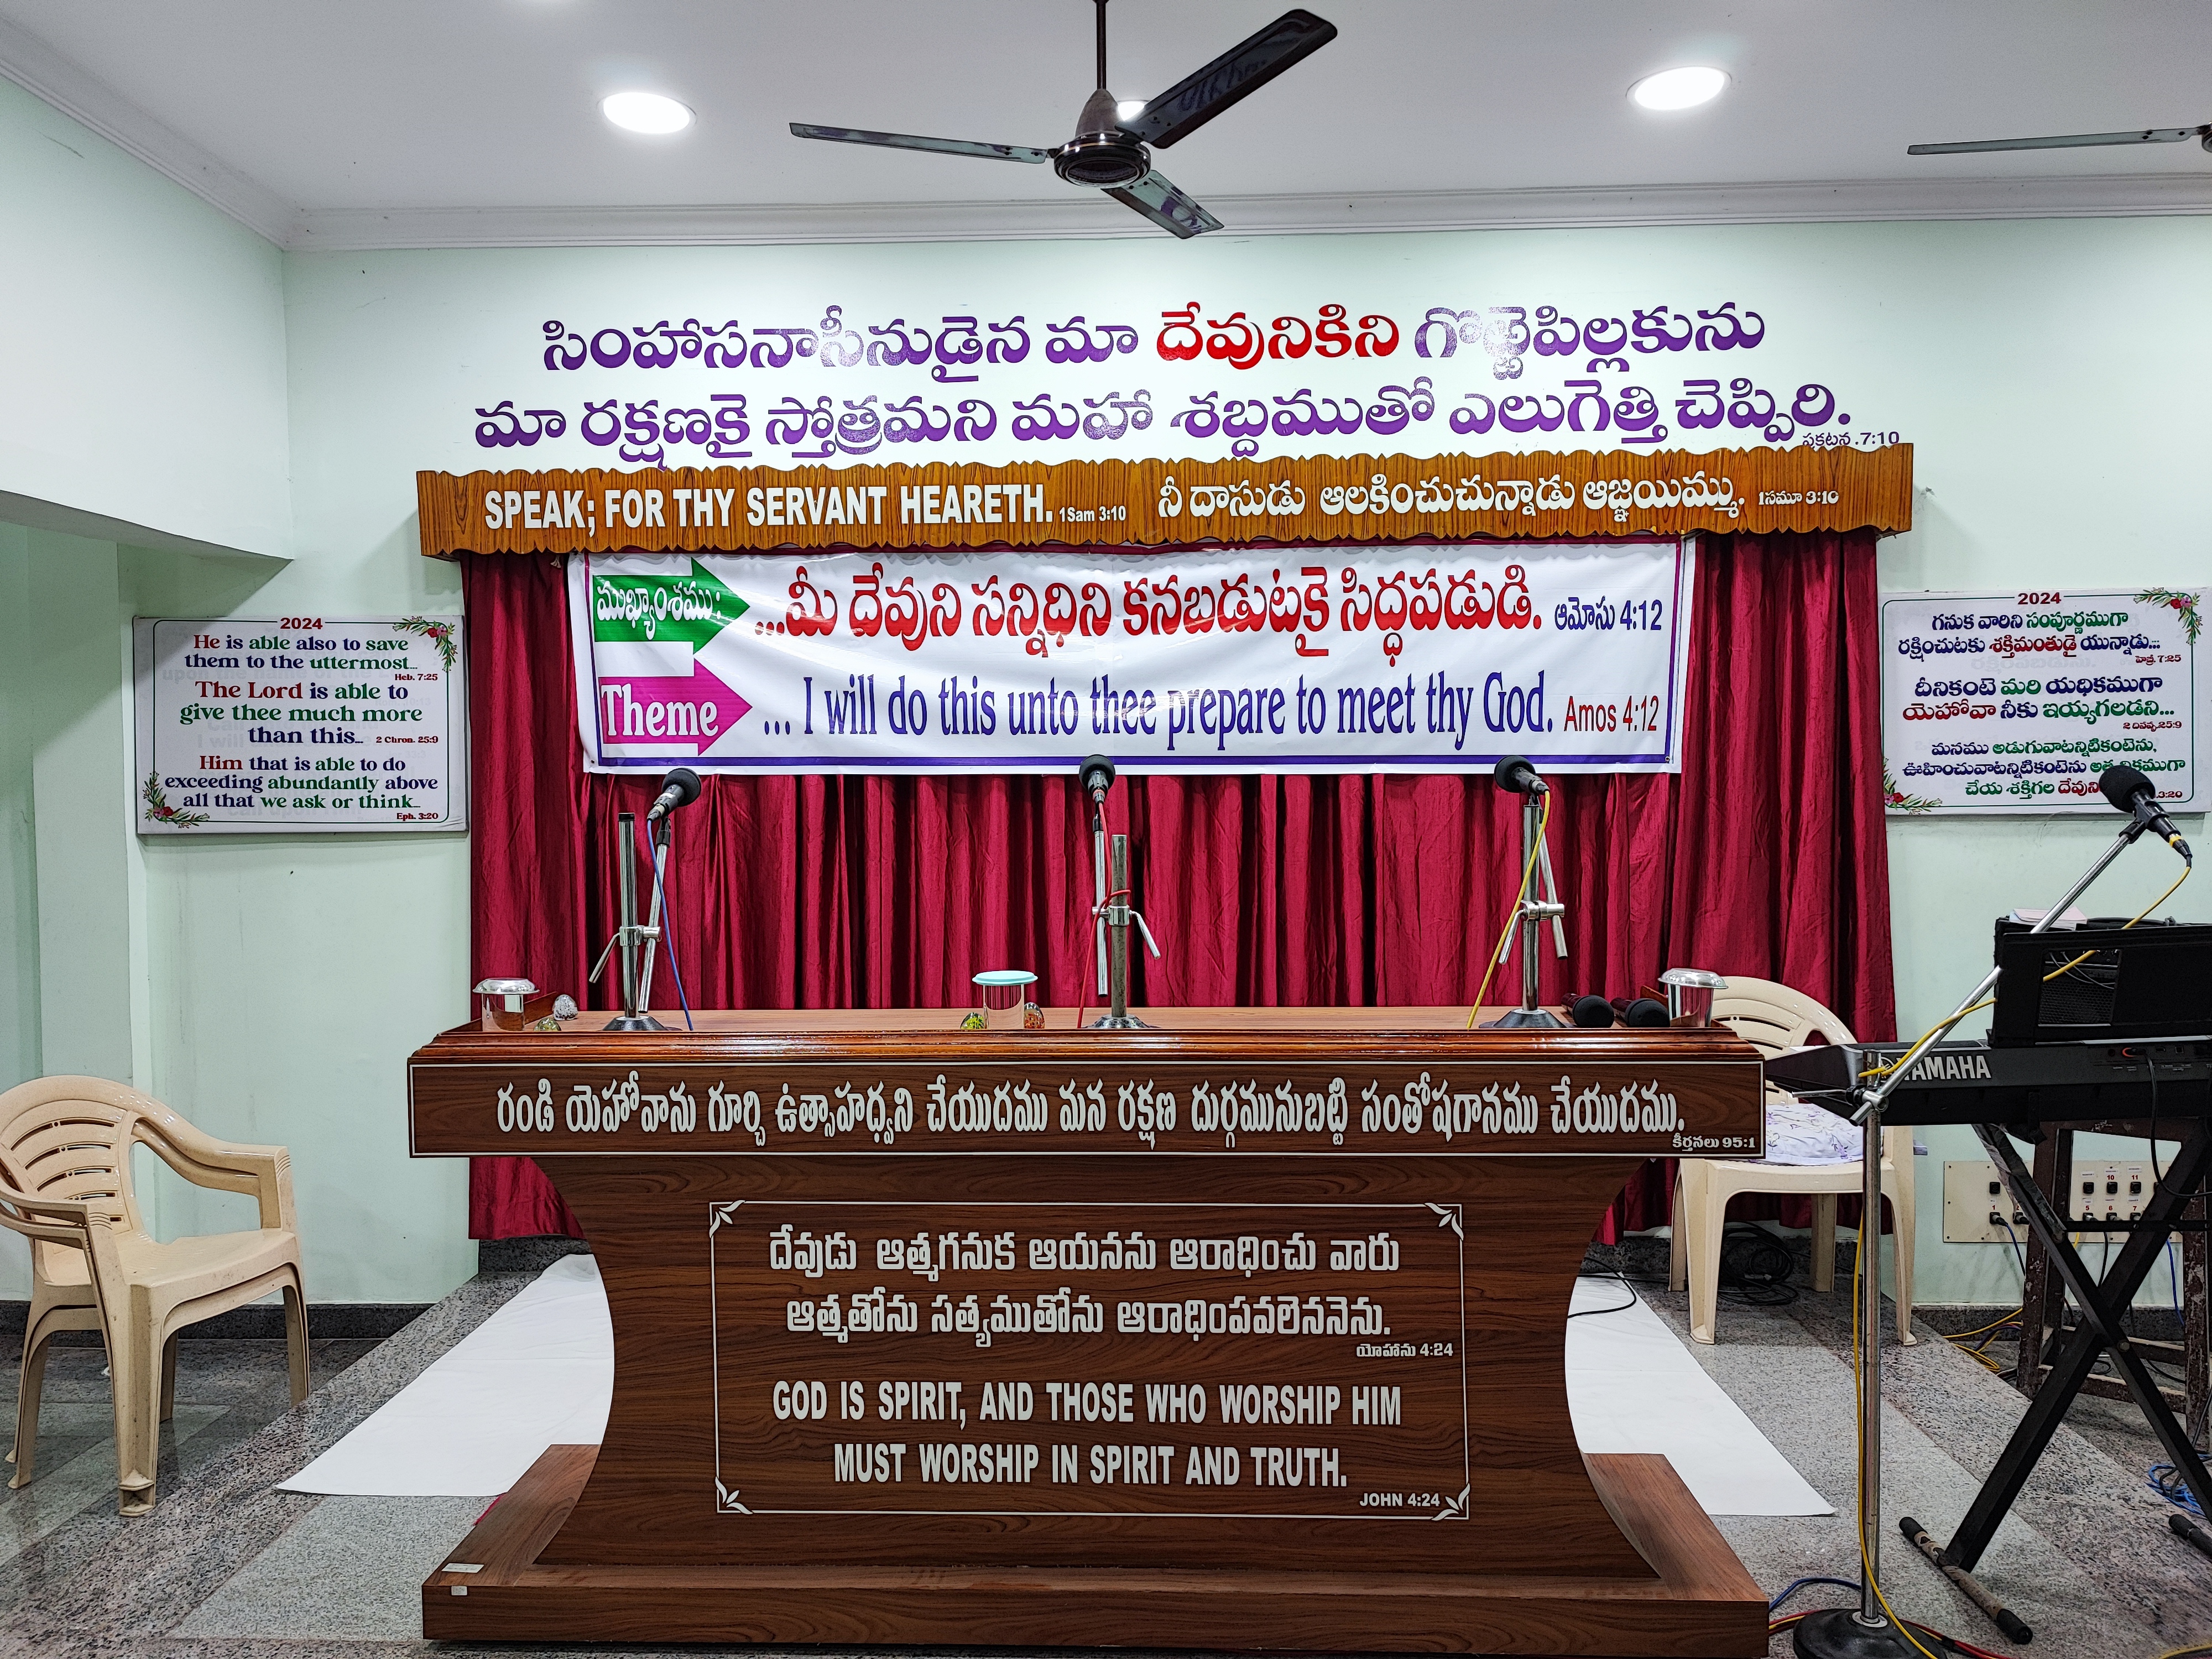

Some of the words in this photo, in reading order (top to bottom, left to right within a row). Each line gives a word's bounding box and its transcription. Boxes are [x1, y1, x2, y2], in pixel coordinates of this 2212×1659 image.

[542, 305, 1030, 383] సింహాసనాసీనుడైన
[1045, 315, 1140, 365] మా
[1157, 302, 1400, 371] దేవునికిని
[476, 400, 567, 449] మా
[581, 394, 753, 471] రక్షణకై
[766, 394, 998, 458] స్తోత్రమని
[1012, 390, 1153, 442] మహా
[1171, 377, 1436, 458] శబ్దముతో
[1449, 379, 1669, 445] ఎలుగెత్తి
[1676, 378, 1851, 443] చెప్పిరి.
[1159, 476, 1183, 518] నీ
[1190, 480, 1306, 518] దాసుడు
[1320, 474, 1576, 517] ఆలకించుచున్నాడు
[1583, 471, 1745, 523] ఆజ్ఞయిమ్ము.
[1806, 491, 1839, 505] 3:10
[486, 491, 596, 538] SPEAK;
[606, 489, 666, 529] FOR
[673, 489, 736, 528] THY
[747, 487, 888, 527] SERVANT
[901, 484, 1053, 525] HEARETH.
[1060, 507, 1095, 523] 1Sam
[1099, 506, 1126, 522] 3:10
[2018, 592, 2062, 606] 2024
[280, 618, 324, 630] 2024
[849, 563, 962, 652] దేవుని
[972, 576, 1112, 658] సన్నిధిని
[1124, 567, 1331, 658] కనబడుటకై
[1340, 565, 1542, 667] సిద్ధపడుడి.
[1555, 596, 1616, 632] ఆమోసు
[1620, 599, 1663, 632] 4:12
[1932, 614, 1975, 631] గనుక
[1978, 614, 2024, 630] వారిని
[2026, 611, 2129, 635] సంపూర్ణముగా
[193, 634, 221, 650] He
[226, 635, 244, 650] is
[249, 635, 291, 650] able
[296, 637, 337, 651] also
[343, 639, 361, 651] to
[366, 640, 409, 651] save
[1898, 637, 1986, 663] రక్షించుటకు
[1989, 635, 2078, 659] శక్తిమంతుడై
[185, 654, 241, 669] them
[246, 655, 265, 669] to
[270, 655, 305, 670] the
[2158, 655, 2182, 664] 7:25
[195, 681, 242, 698] The
[248, 682, 304, 700] Lord
[310, 682, 329, 700] is
[335, 683, 382, 700] able
[388, 685, 409, 700] to
[1915, 677, 1997, 697] దీనికంటె
[2001, 679, 2042, 696] మరి
[180, 703, 225, 726] give
[232, 704, 282, 722] thee
[289, 705, 357, 722] much
[362, 709, 423, 722] more
[601, 684, 719, 738] Theme
[805, 678, 813, 734] I
[825, 676, 877, 735] will
[889, 677, 928, 736] do
[940, 677, 997, 735] this
[1009, 681, 1079, 735] unto
[1091, 676, 1156, 735] thee
[1169, 688, 1286, 751] prepare
[1297, 679, 1327, 735] to
[1339, 677, 1416, 734] meet
[1427, 672, 1474, 750] thy
[1484, 672, 1553, 734] God.
[1566, 698, 1616, 732] Amos
[1624, 696, 1658, 732] 4:12
[1903, 698, 1997, 721] యెహోవా
[2000, 700, 2039, 719] నీకు
[249, 726, 304, 744] than
[418, 736, 439, 744] 25:9
[1932, 742, 1990, 757] మనము
[200, 755, 244, 771] Him
[249, 757, 289, 771] that
[294, 757, 311, 771] is
[315, 757, 356, 771] able
[361, 759, 378, 772] to
[383, 757, 406, 771] do
[165, 774, 264, 793] exceeding
[268, 775, 379, 794] abundantly
[385, 776, 439, 790] above
[1965, 780, 2004, 796] చేయ
[2006, 780, 2056, 800] శక్తిగల
[183, 793, 210, 808] all
[215, 792, 255, 808] that
[260, 797, 288, 808] we
[293, 795, 327, 809] ask
[332, 798, 354, 809] or
[397, 813, 417, 822] Eph.
[498, 1079, 555, 1133] రండి
[566, 1071, 697, 1133] యెహోవాను
[708, 1081, 766, 1147] గూర్చి
[927, 1074, 1048, 1132] చేయుదము
[1060, 1079, 1107, 1132] మన
[1118, 1079, 1177, 1149] రక్షణ
[1192, 1078, 1349, 1149] దుర్గమునుబట్టి
[1361, 1072, 1539, 1142] సంతోషగానము
[1551, 1075, 1685, 1134] చేయుదము.
[1672, 1133, 1720, 1151] కీర్తనలు
[1723, 1137, 1756, 1149] 95:1
[770, 1224, 857, 1278] దేవుడు
[877, 1232, 1016, 1282] ఆత్మగనుక
[1030, 1232, 1156, 1270] ఆయనను
[1171, 1233, 1316, 1278] ఆరాధించు
[1331, 1233, 1400, 1271] వారు
[787, 1287, 918, 1344] ఆత్మతోను
[932, 1287, 1104, 1347] సత్యముతోను
[1357, 1344, 1416, 1358] యోహాను
[1420, 1343, 1454, 1357] 4:24
[774, 1381, 827, 1420] GOD
[841, 1381, 865, 1421] IS
[879, 1381, 966, 1430] SPIRIT,
[980, 1383, 1034, 1421] AND
[1046, 1383, 1134, 1422] THOSE
[1146, 1385, 1207, 1424] WHO
[1220, 1385, 1341, 1425] WORSHIP
[1353, 1386, 1401, 1426] HIM
[835, 1443, 906, 1483] MUST
[919, 1444, 1039, 1483] WORSHIP
[1053, 1445, 1078, 1484] IN
[1091, 1445, 1175, 1485] SPIRIT
[1186, 1447, 1240, 1485] AND
[1251, 1448, 1347, 1487] TRUTH.
[1360, 1494, 1403, 1507] JOHN
[1408, 1494, 1441, 1507] 4:24
